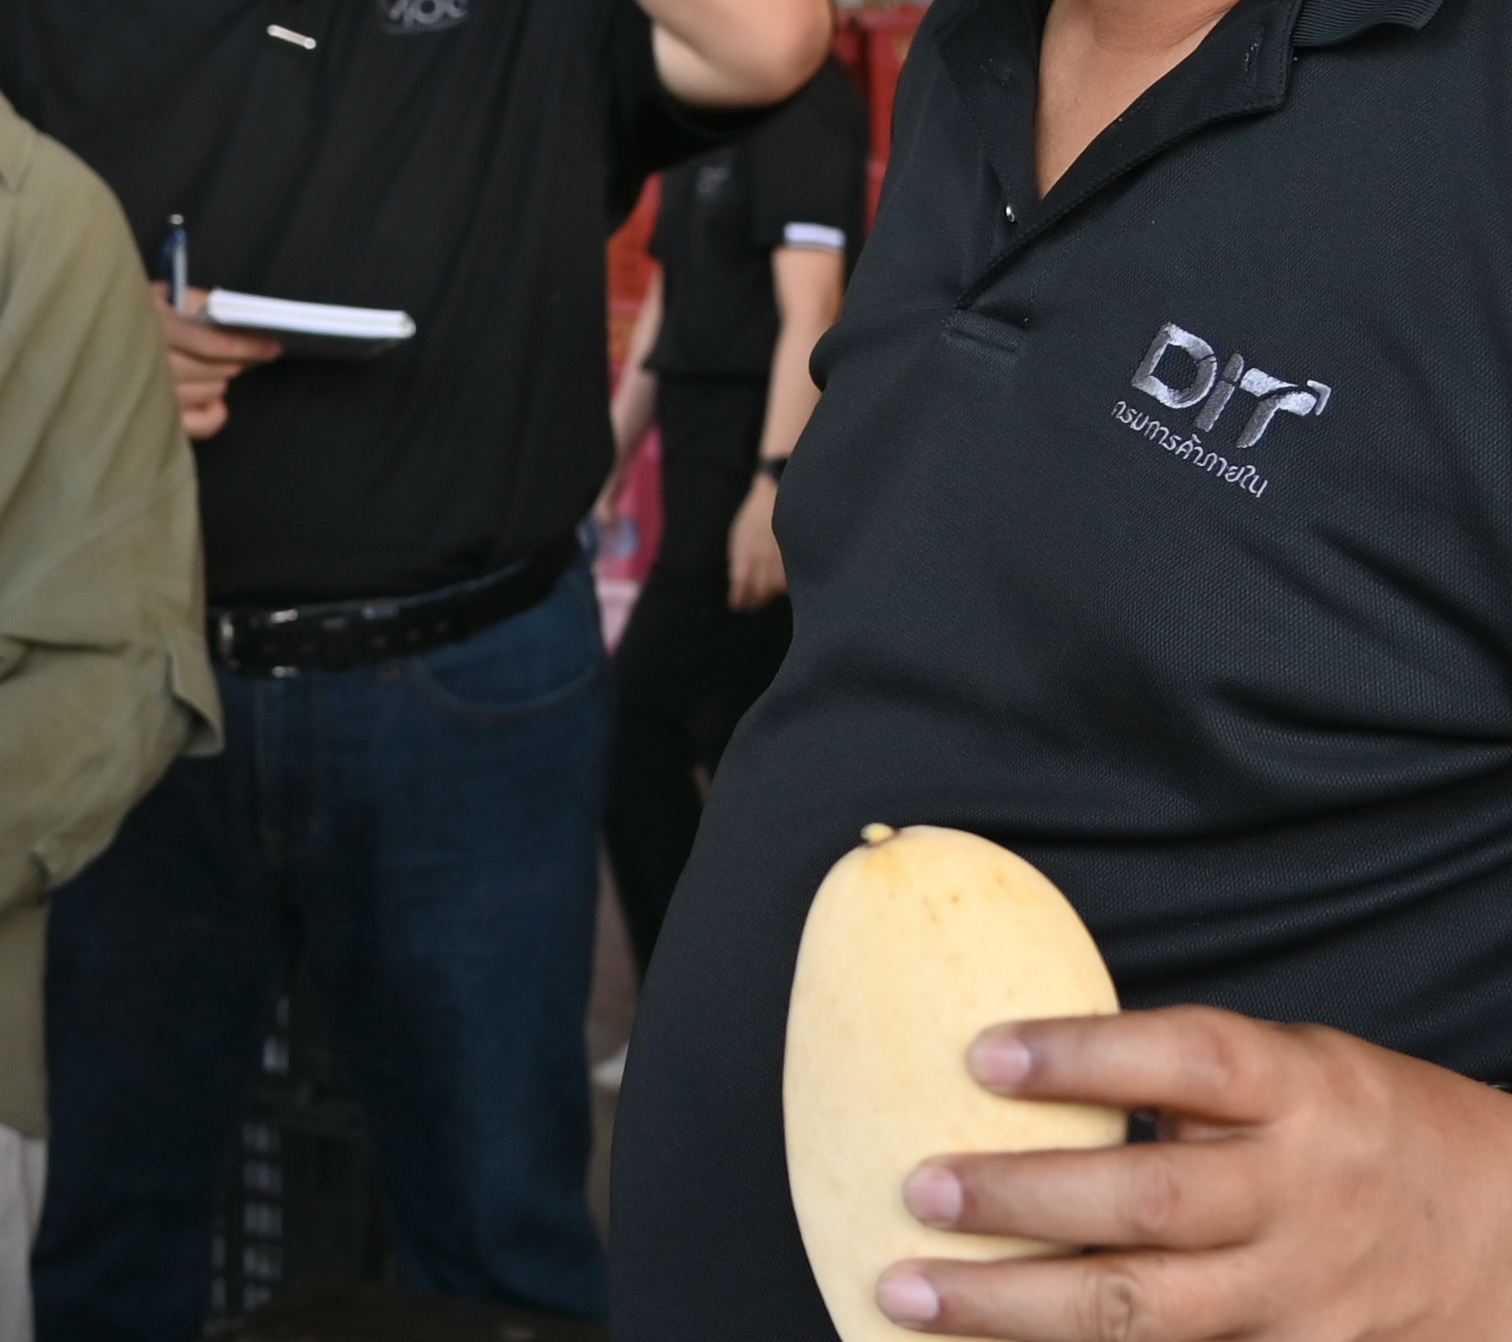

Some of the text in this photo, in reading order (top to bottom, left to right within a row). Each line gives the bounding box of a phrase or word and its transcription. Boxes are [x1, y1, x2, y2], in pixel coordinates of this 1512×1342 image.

[1110, 400, 1269, 498] กรมการค้าภายใน
